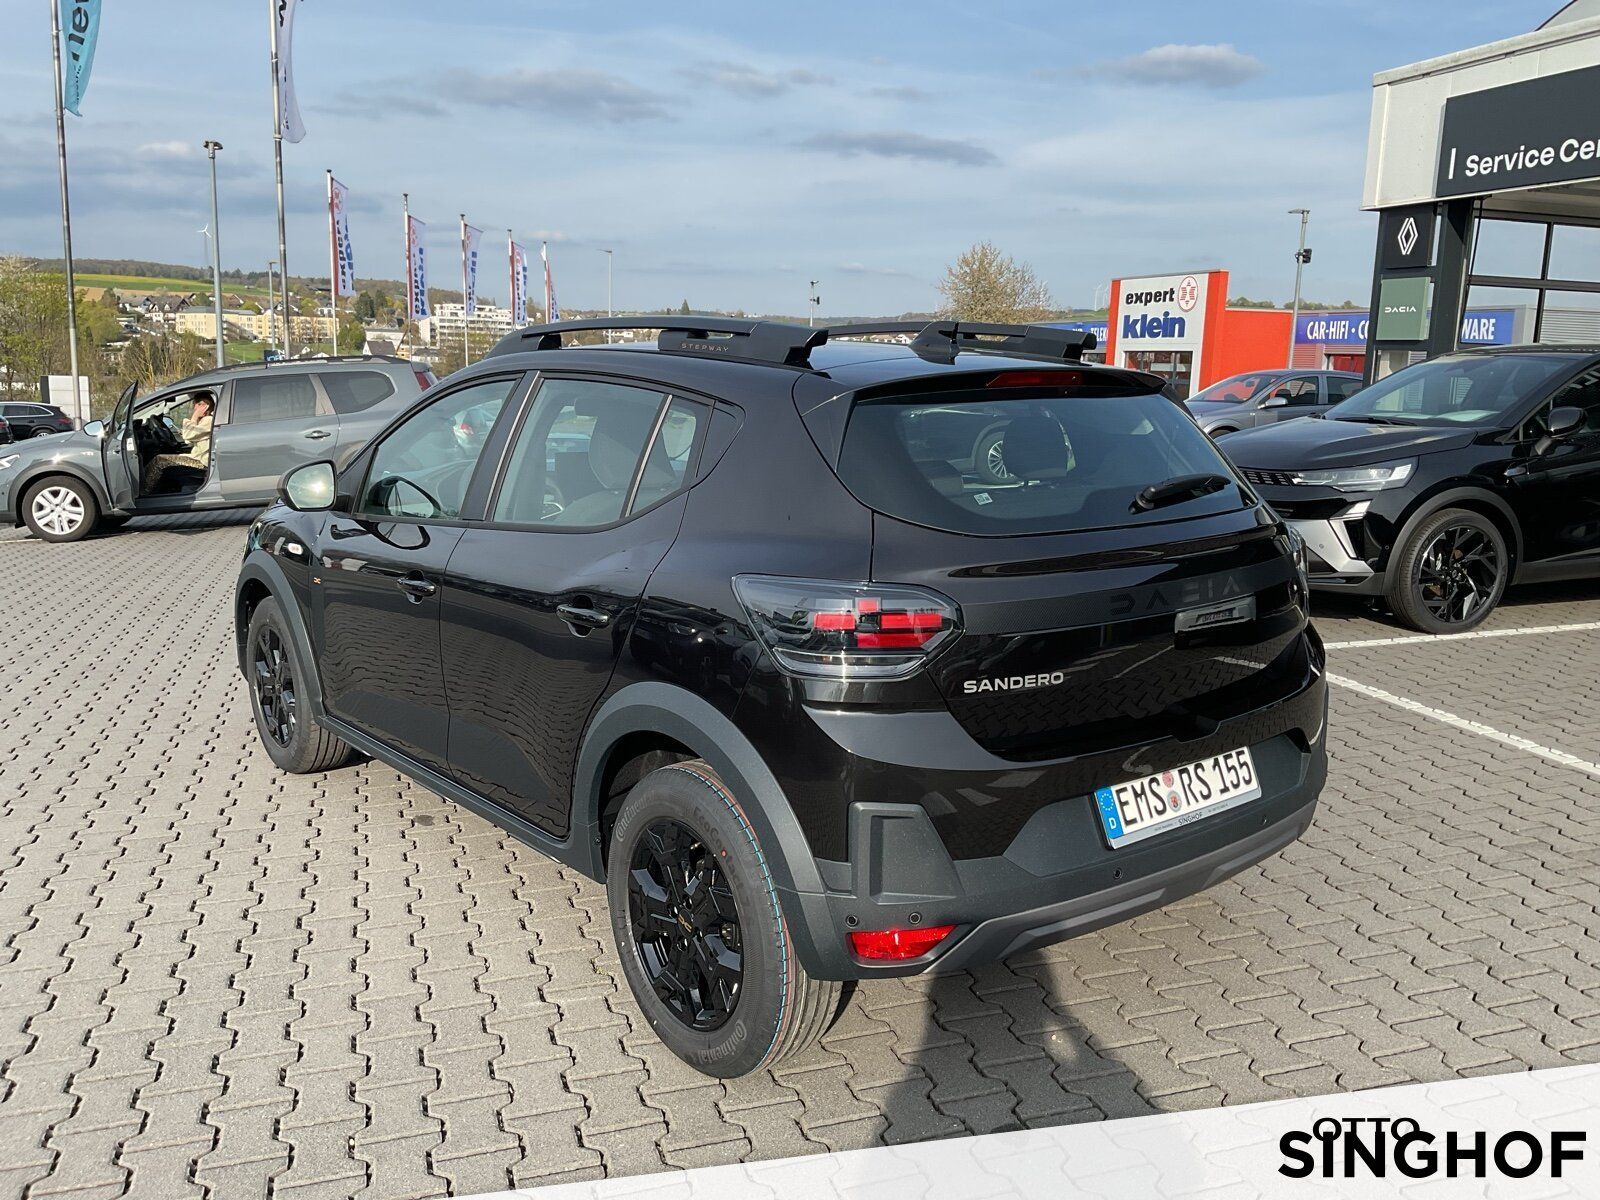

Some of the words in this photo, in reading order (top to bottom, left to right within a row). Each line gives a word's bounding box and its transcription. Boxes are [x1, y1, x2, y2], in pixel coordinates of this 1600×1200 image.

[1465, 145, 1555, 177] Service
[1125, 287, 1175, 306] expert
[1122, 311, 1186, 339] klein
[1306, 320, 1350, 340] CAR-HIFI
[681, 343, 729, 352] STEPWAY
[1110, 575, 1241, 616] DACIA
[963, 671, 1064, 693] SANDERO
[1115, 777, 1167, 827] EMS
[1178, 762, 1212, 806] RS
[1212, 750, 1253, 796] 155
[1109, 818, 1117, 830] D
